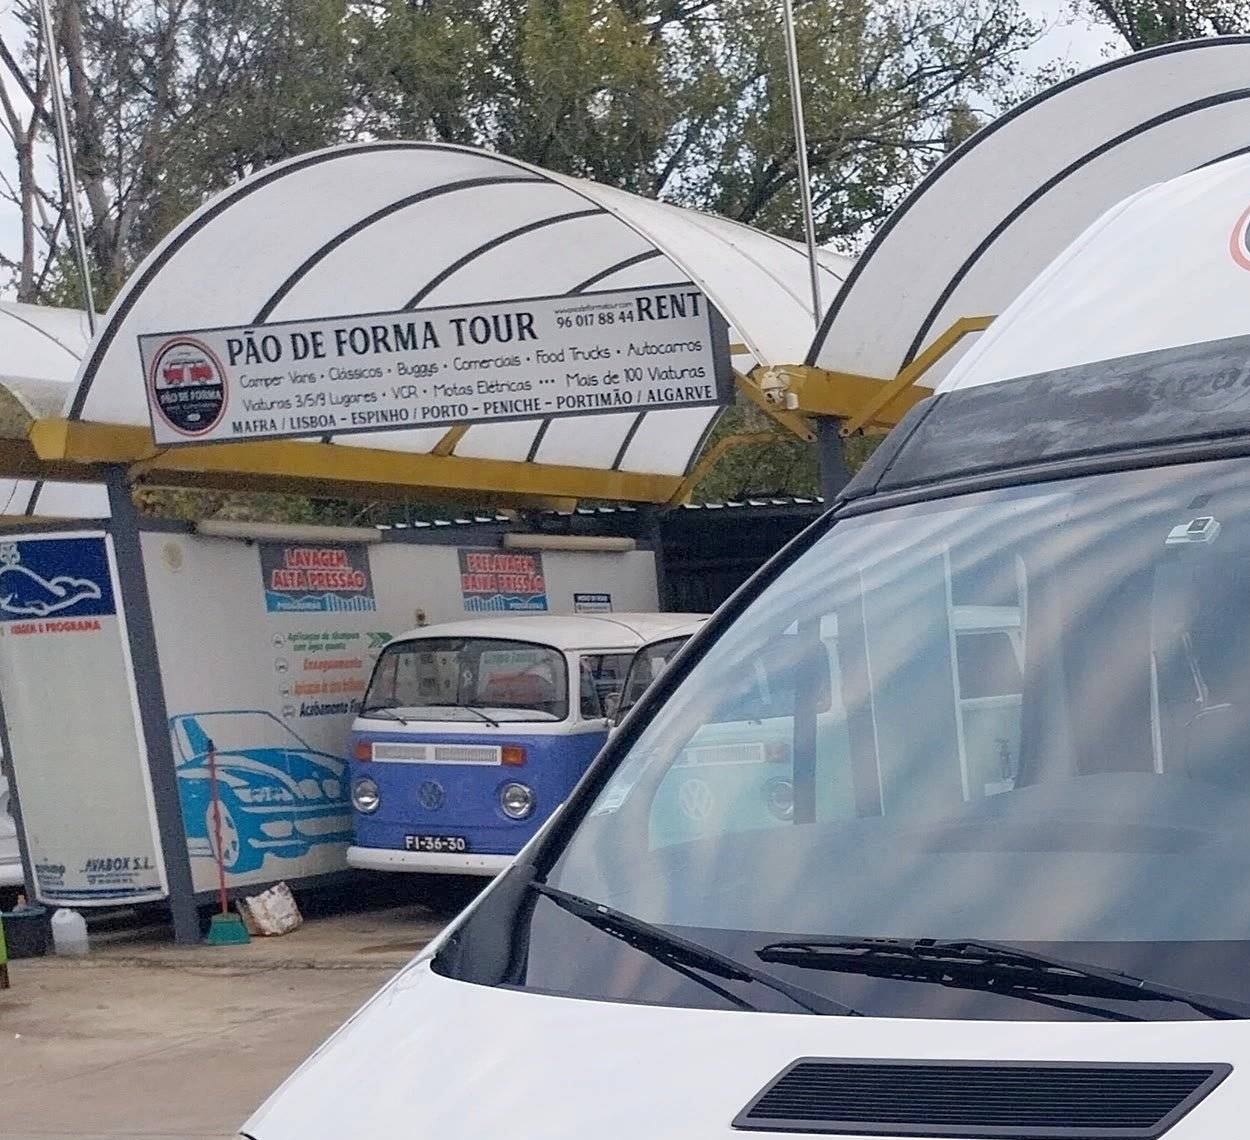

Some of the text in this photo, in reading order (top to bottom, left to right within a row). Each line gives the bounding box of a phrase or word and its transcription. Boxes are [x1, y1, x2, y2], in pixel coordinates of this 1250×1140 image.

[557, 310, 634, 328] 96 017 88 44
[635, 292, 702, 322] RENT
[226, 313, 539, 366] PÃO DE FORMA TOUR
[240, 374, 284, 389] Camper
[288, 371, 317, 384] Vans
[397, 362, 439, 377] Buggys
[453, 355, 522, 371] Comerciais
[536, 349, 565, 364] Food
[569, 346, 611, 361] Trucks
[627, 340, 703, 357] Autocarros
[242, 397, 293, 412] Viaturas
[330, 391, 378, 408] Lugares
[433, 384, 473, 397] Motas
[566, 373, 599, 388] Mais
[602, 370, 620, 385] de
[624, 367, 643, 383] 100
[647, 365, 706, 382] Viaturas
[231, 417, 277, 434] MAFRA
[290, 414, 337, 430] LISBOA
[351, 408, 409, 425] ESPINHO
[422, 403, 469, 419] PORTO
[483, 398, 541, 414] PENICHE
[557, 388, 633, 409] PORTIMÃO
[648, 385, 713, 403] ALGARVE
[285, 548, 348, 569] LAVAGEM
[272, 570, 306, 590] ALTA
[405, 836, 465, 850] FI-36-30
